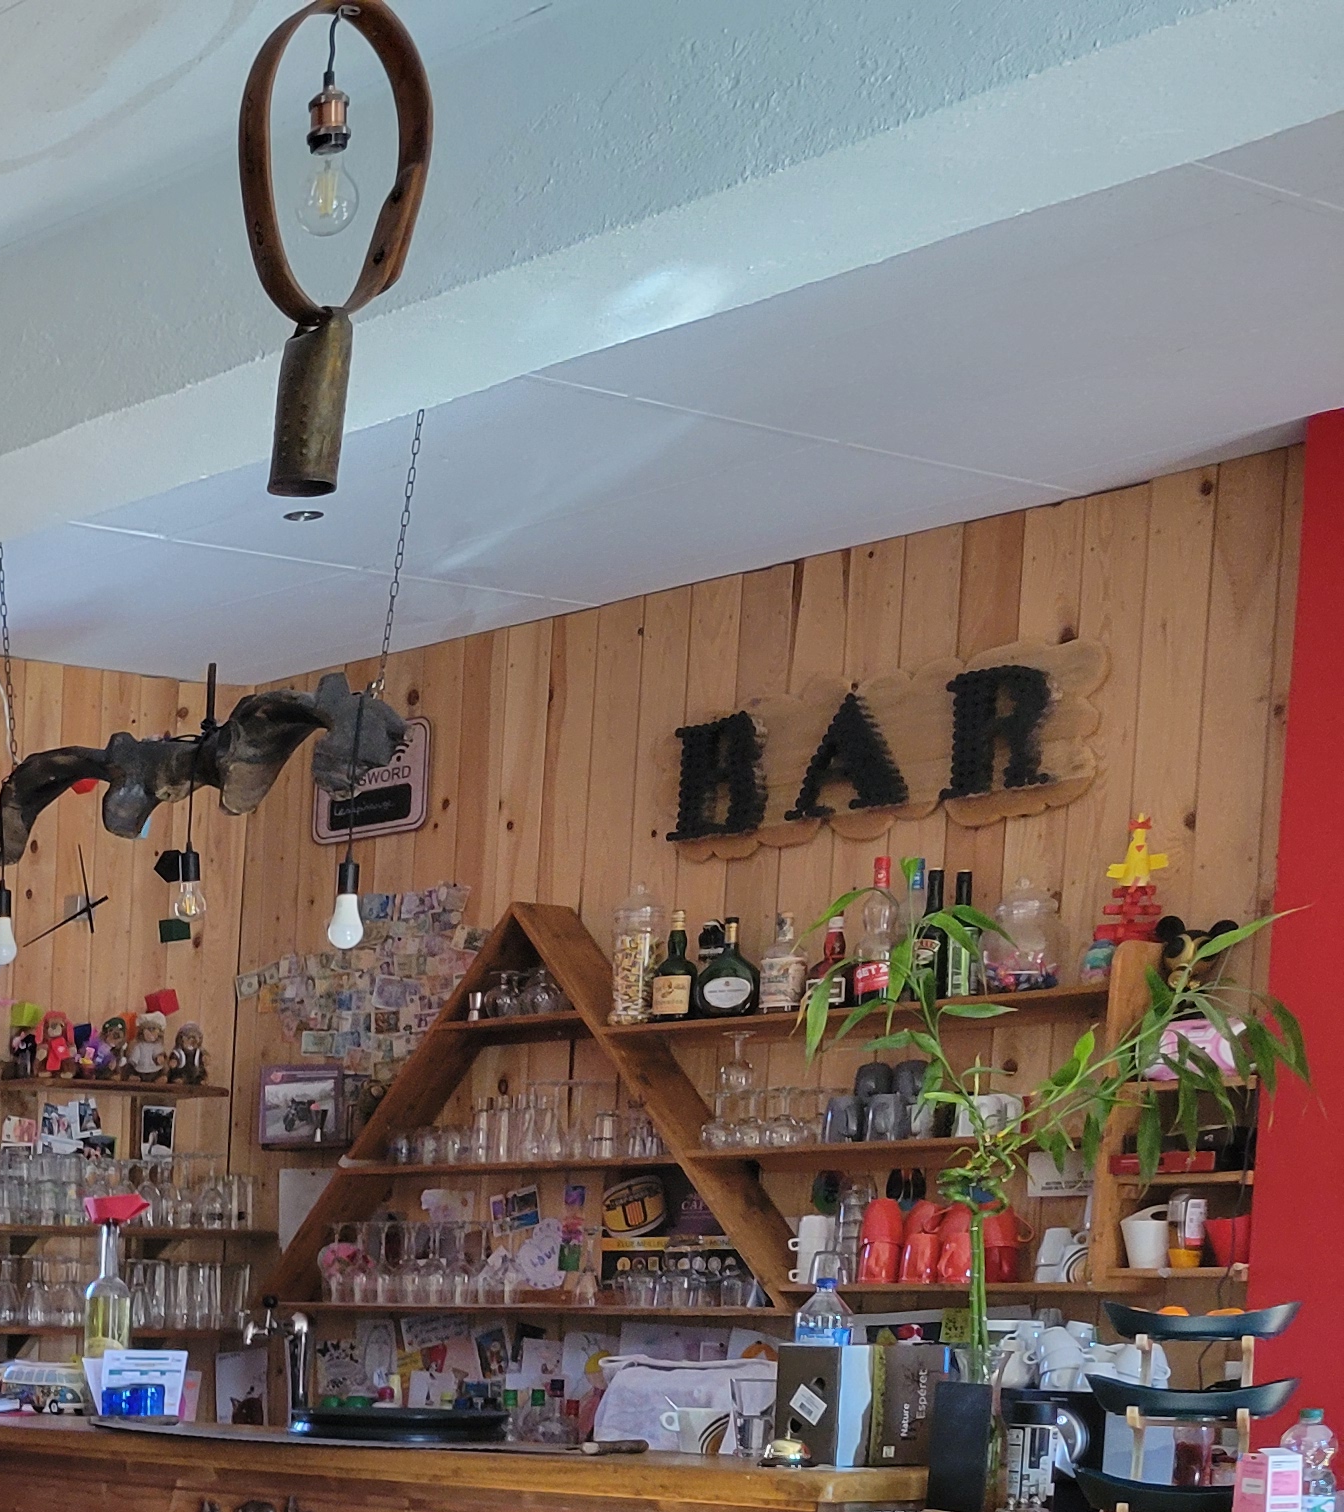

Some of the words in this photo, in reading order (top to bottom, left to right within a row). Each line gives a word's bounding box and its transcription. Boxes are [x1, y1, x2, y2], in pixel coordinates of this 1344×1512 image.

[666, 665, 1052, 841] BAR
[357, 765, 412, 786] SWORD
[856, 965, 877, 979] GET
[900, 1403, 911, 1437] Nature
